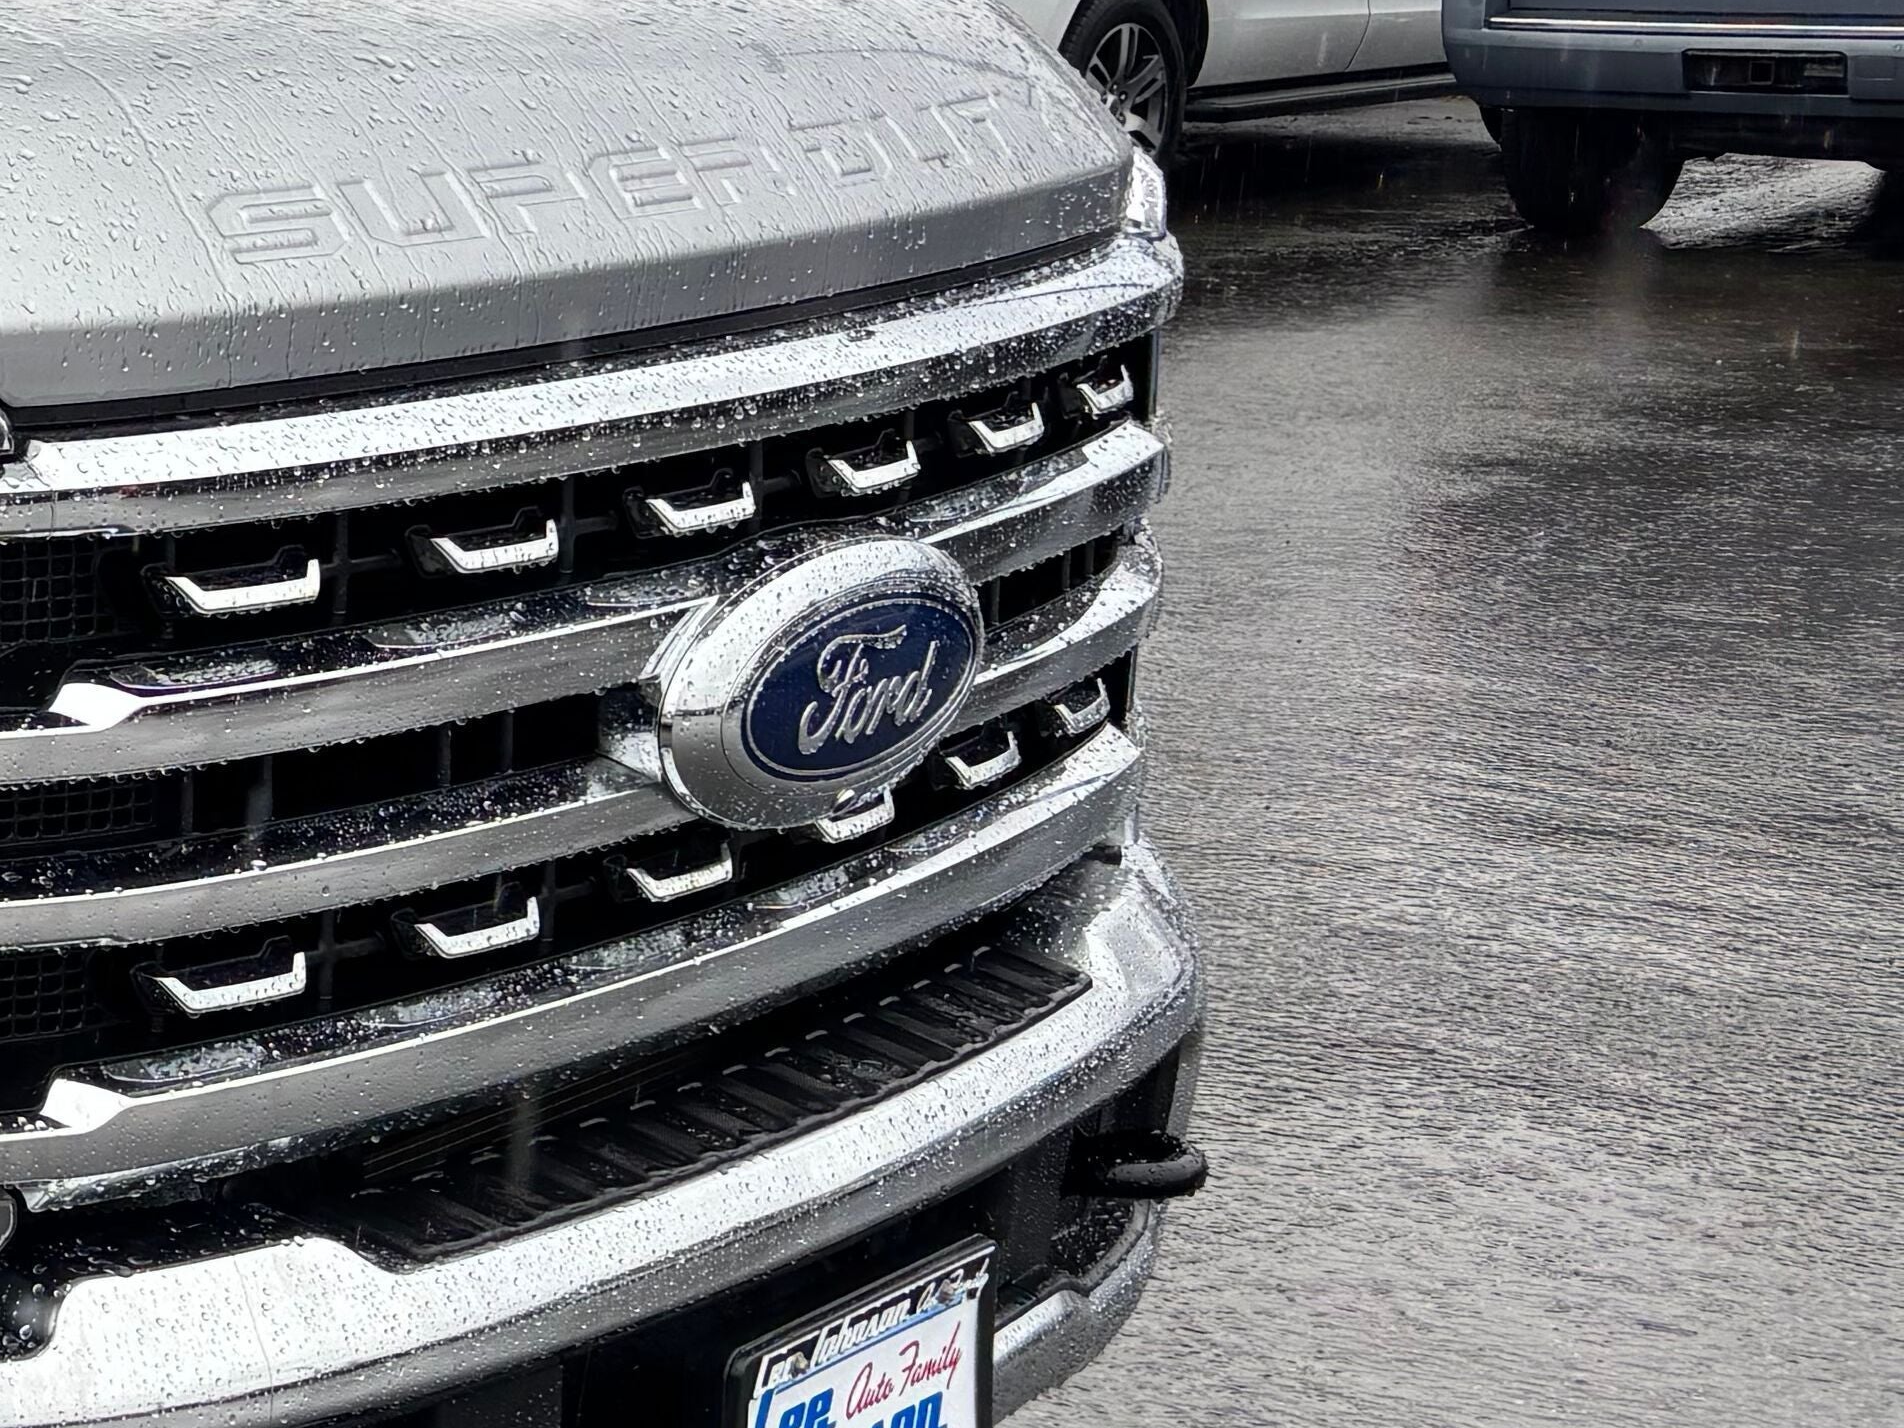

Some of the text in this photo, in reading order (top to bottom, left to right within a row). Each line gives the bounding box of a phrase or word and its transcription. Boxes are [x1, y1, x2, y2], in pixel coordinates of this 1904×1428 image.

[206, 134, 800, 266] SUPER
[796, 623, 941, 756] Ford
[810, 1297, 912, 1368] Johnson
[844, 1360, 894, 1421] Auto
[898, 1319, 962, 1397] Family
